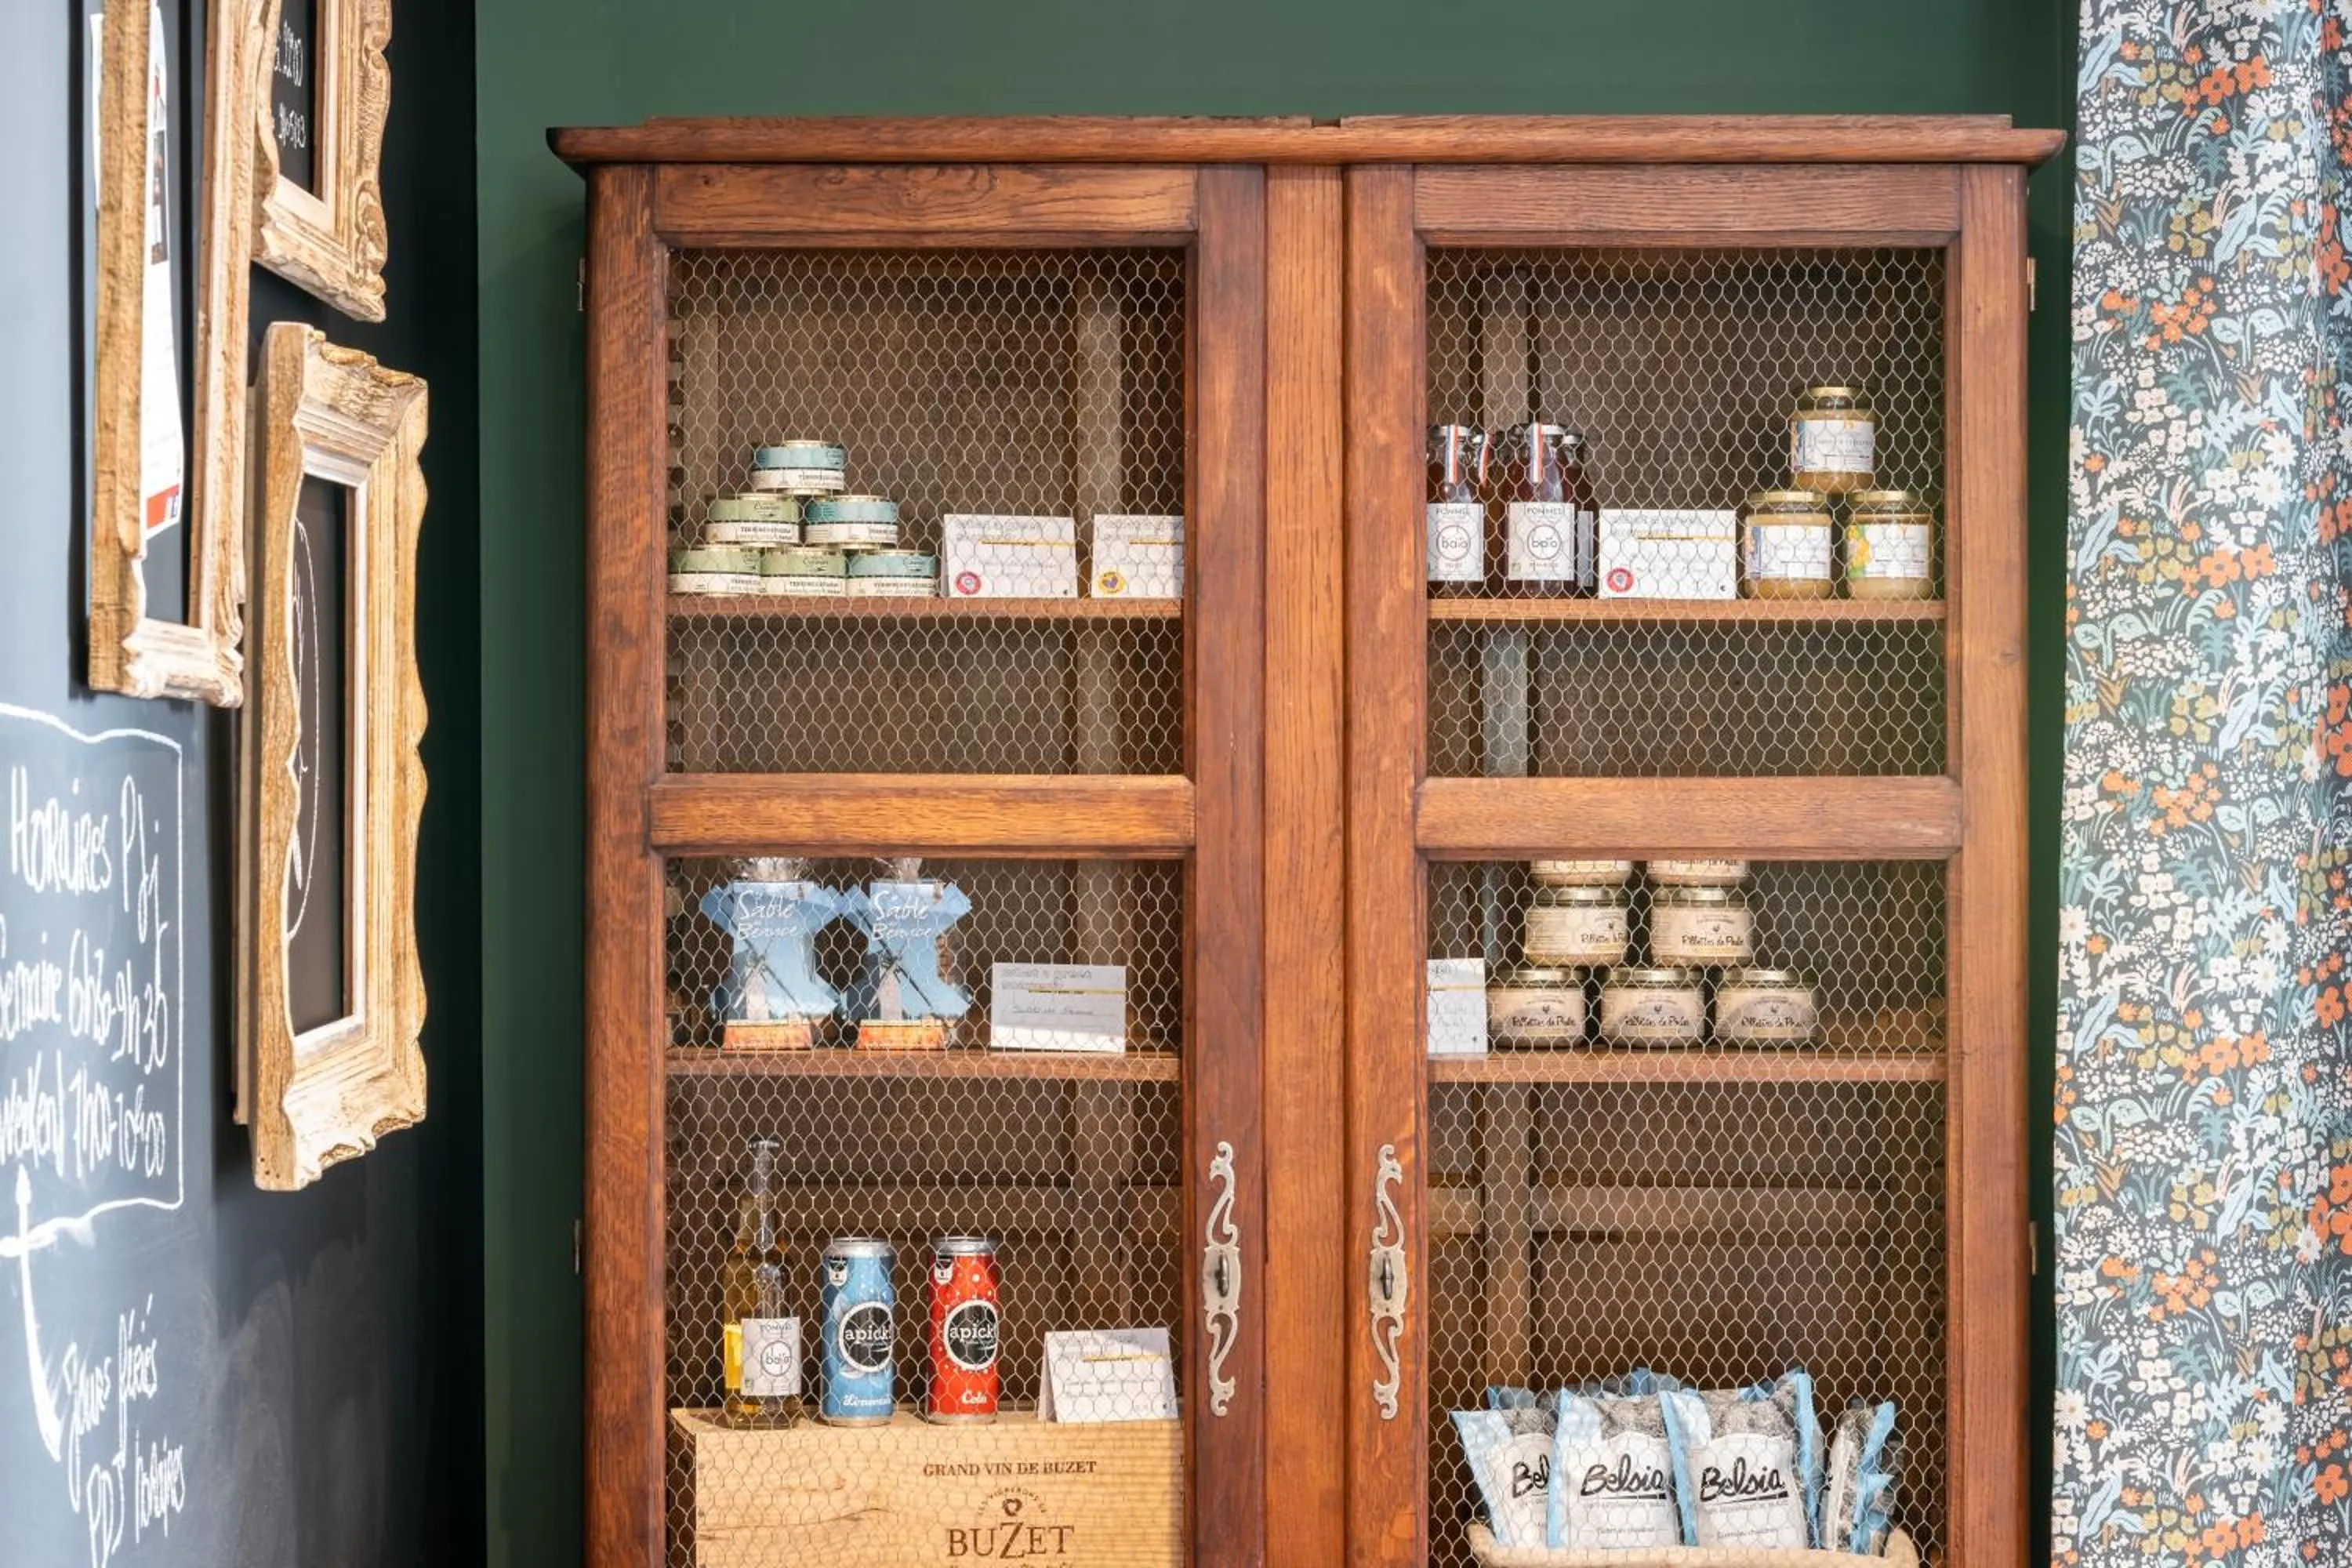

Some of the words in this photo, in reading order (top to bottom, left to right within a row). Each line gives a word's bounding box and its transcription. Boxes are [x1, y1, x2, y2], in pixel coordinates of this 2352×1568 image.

[923, 1463, 980, 1476] GRAND
[984, 1462, 1013, 1475] VIN
[1017, 1462, 1039, 1475] DE
[1044, 1460, 1098, 1475] BUZET
[1580, 1454, 1666, 1497] Belsia
[1700, 1456, 1786, 1502] Belsia
[945, 1521, 1075, 1559] BUZET
